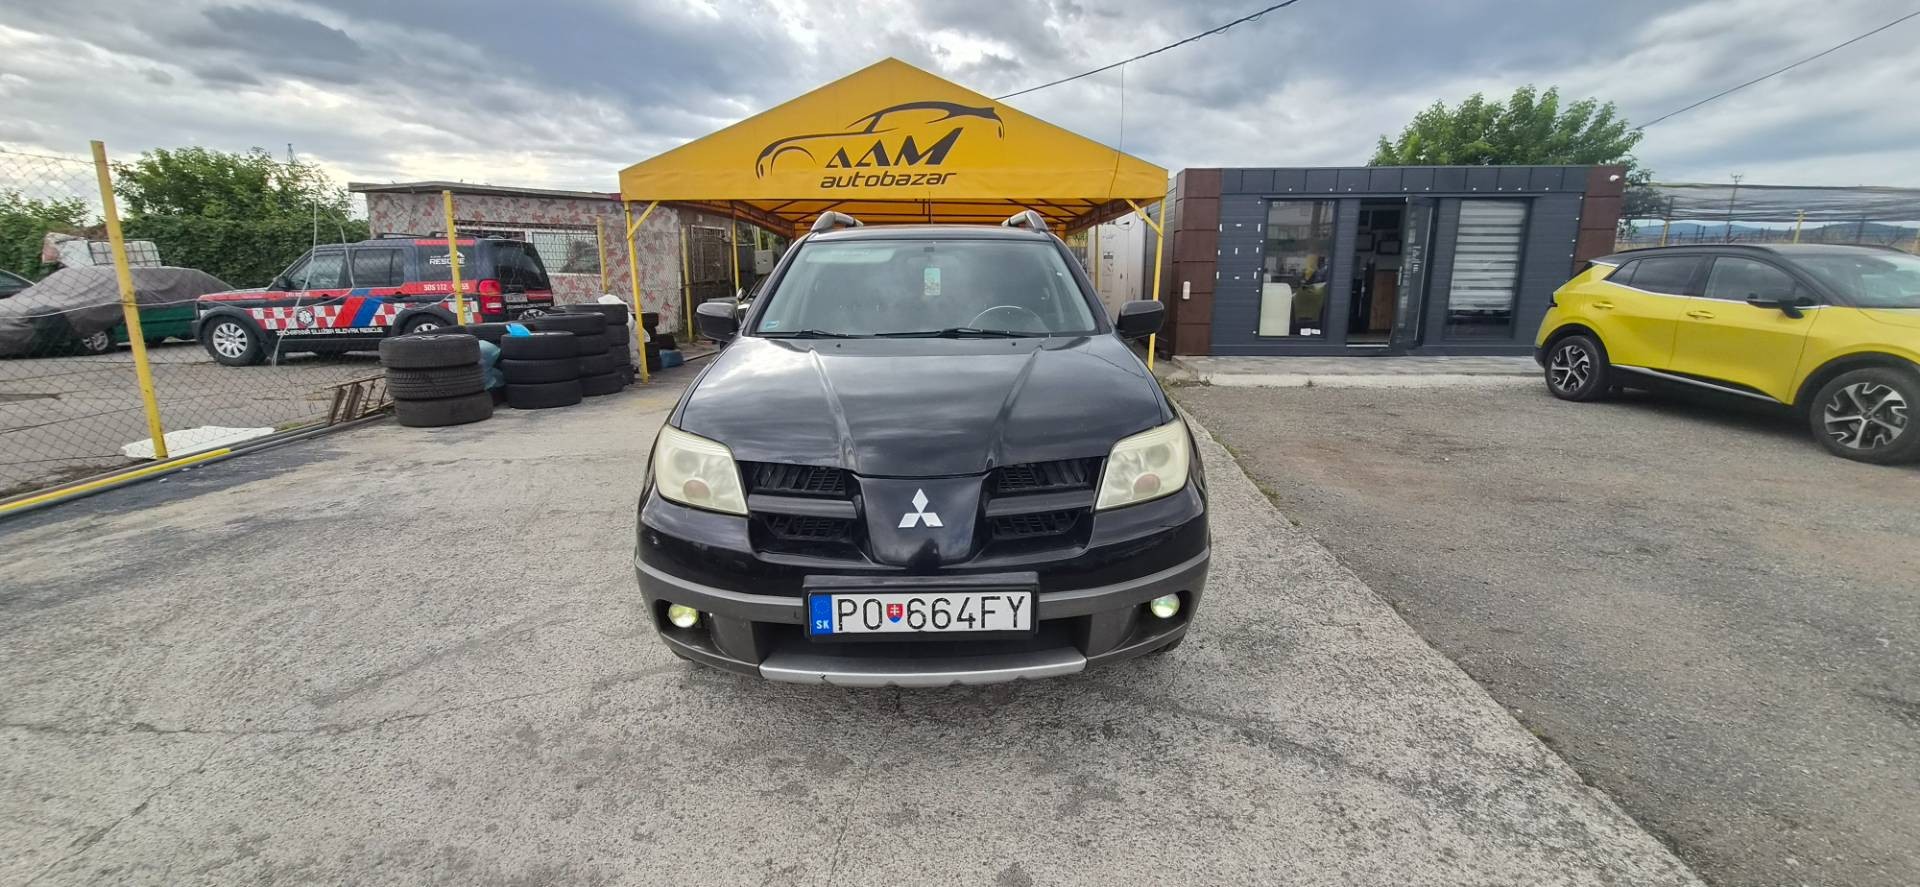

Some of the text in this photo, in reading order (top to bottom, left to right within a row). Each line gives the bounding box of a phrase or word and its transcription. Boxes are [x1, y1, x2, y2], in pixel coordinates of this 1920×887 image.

[825, 127, 964, 169] AAM
[820, 171, 956, 188] autobazar
[816, 620, 830, 630] SK
[906, 596, 1025, 630] 664FY
